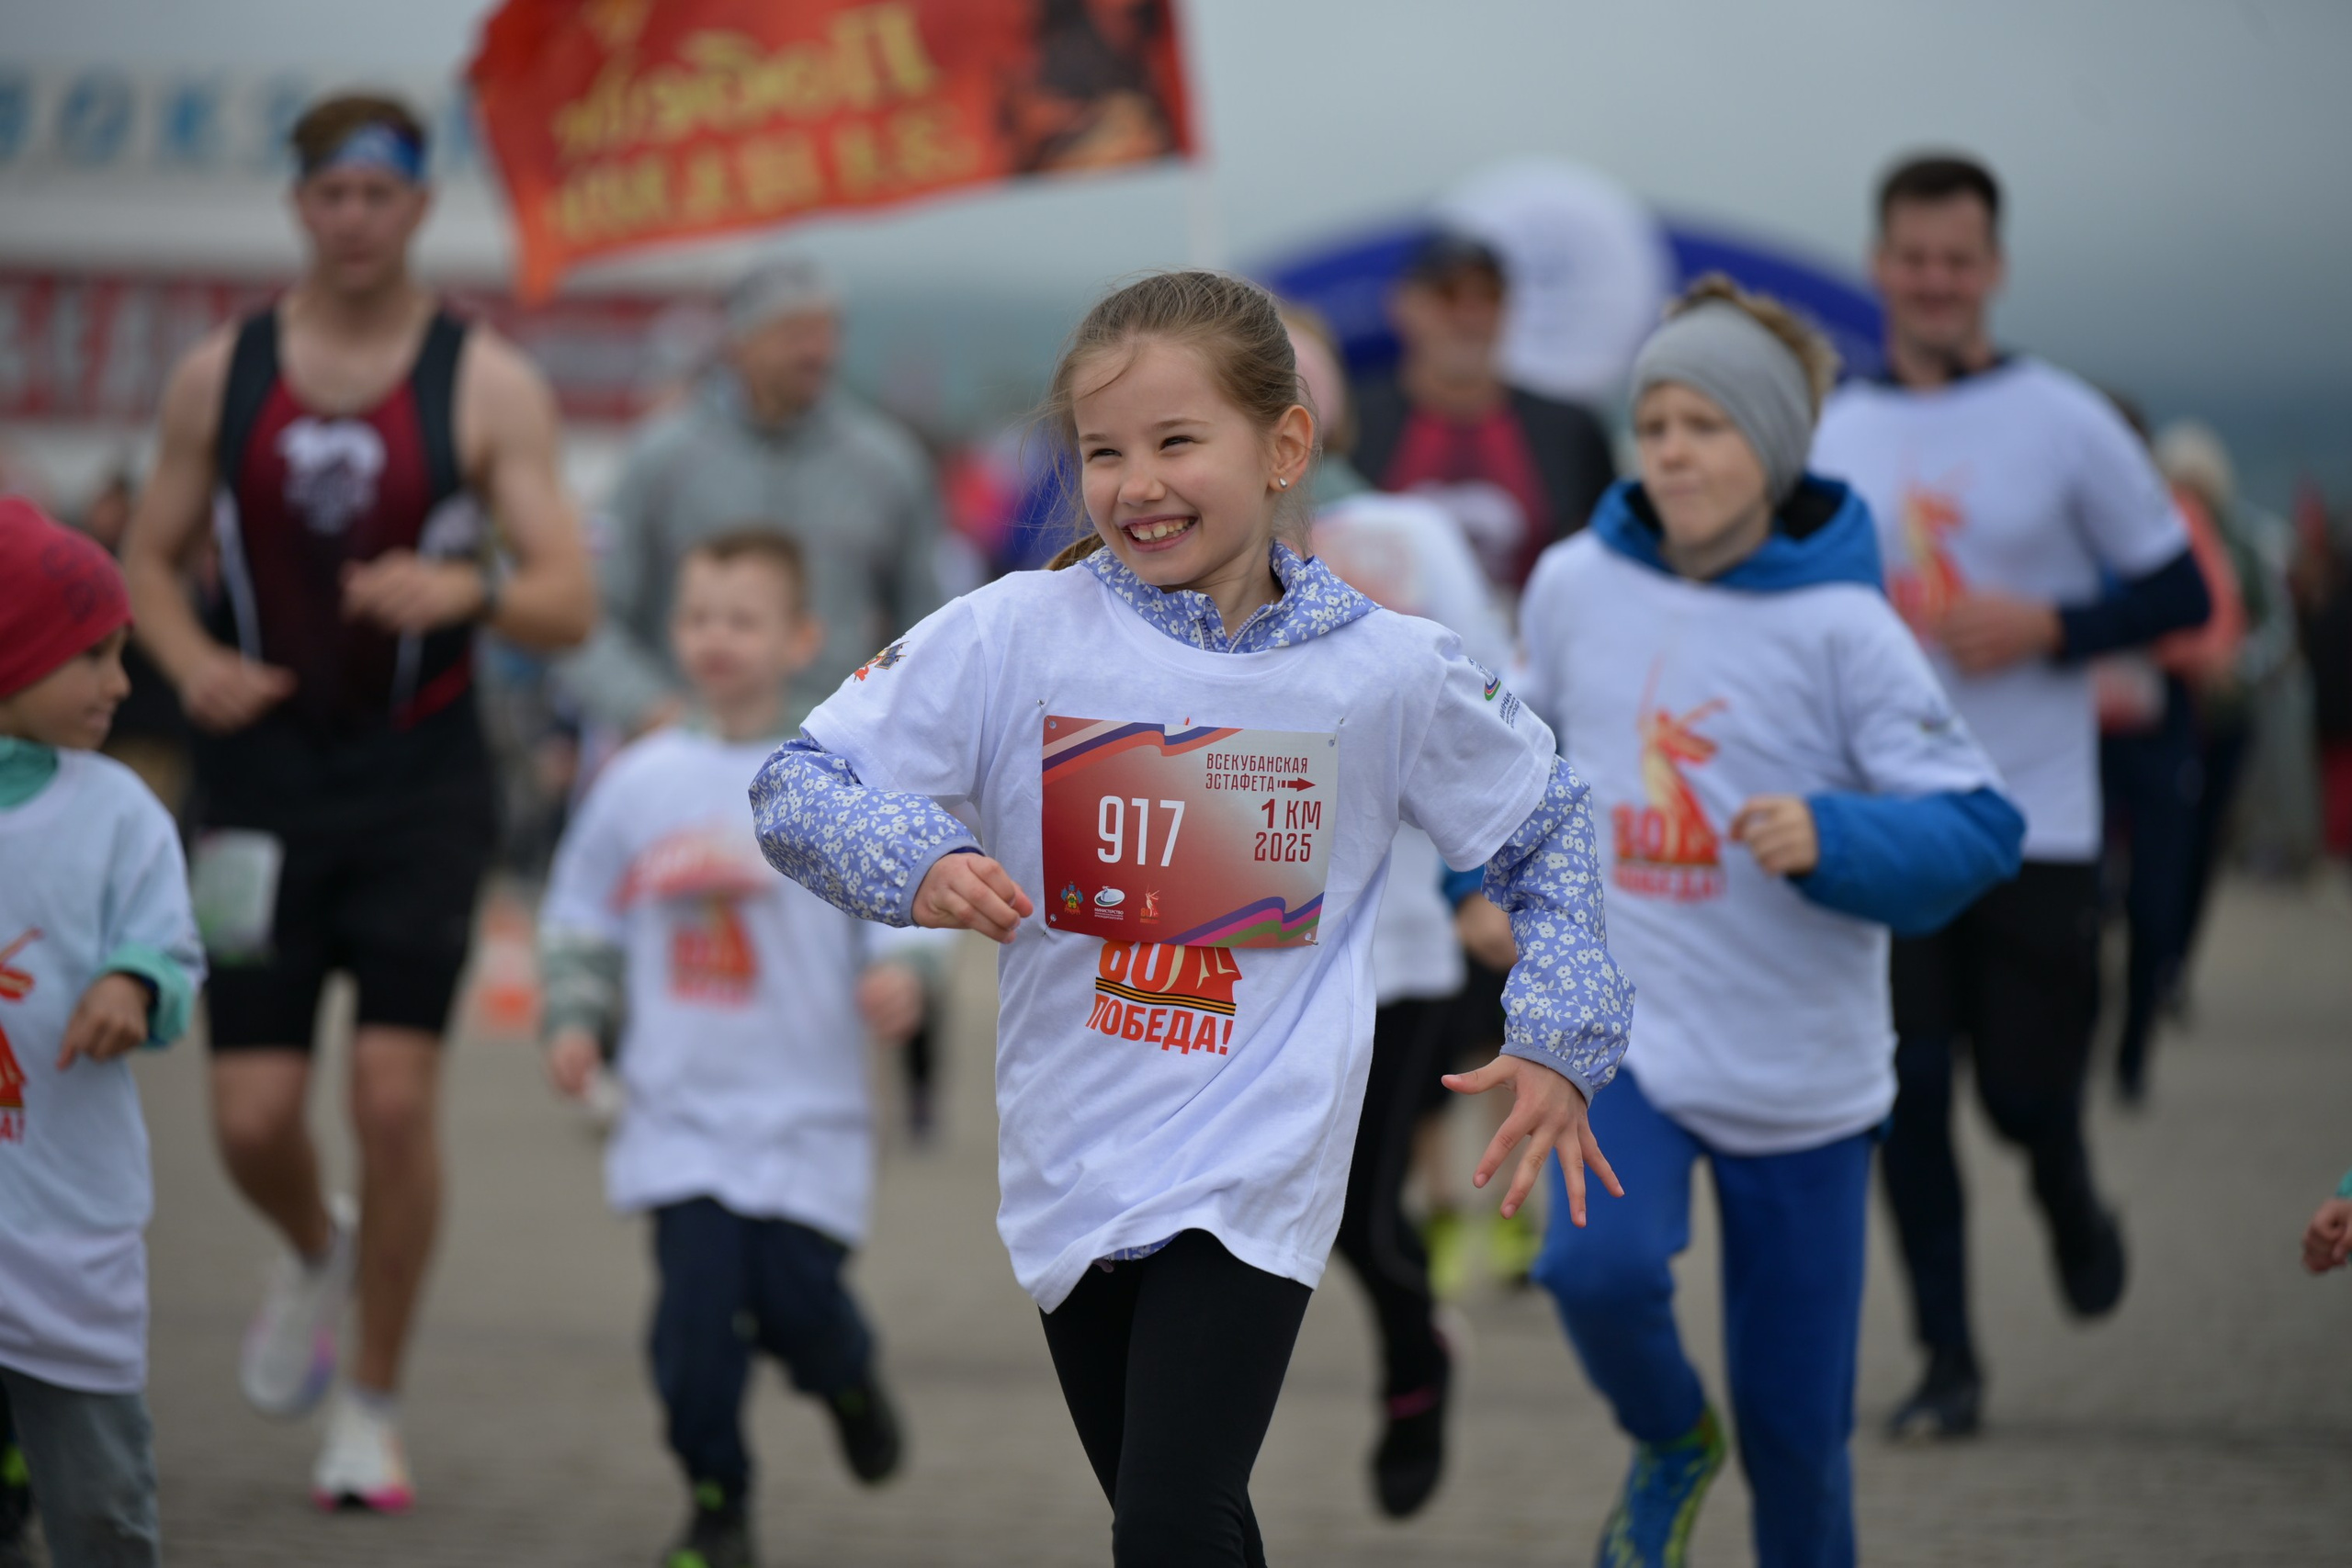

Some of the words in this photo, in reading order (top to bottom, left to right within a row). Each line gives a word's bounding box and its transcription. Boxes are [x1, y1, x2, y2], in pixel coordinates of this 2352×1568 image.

[1206, 753, 1308, 773] ВСЕКУБАНСКАЯ
[1205, 773, 1274, 792] ЭСТАФЕТА
[1261, 798, 1275, 829] 1
[1285, 800, 1321, 830] КМ
[1097, 795, 1185, 866] 917
[1254, 831, 1312, 862] 2025
[1085, 993, 1234, 1055] ПОБЕДА!
